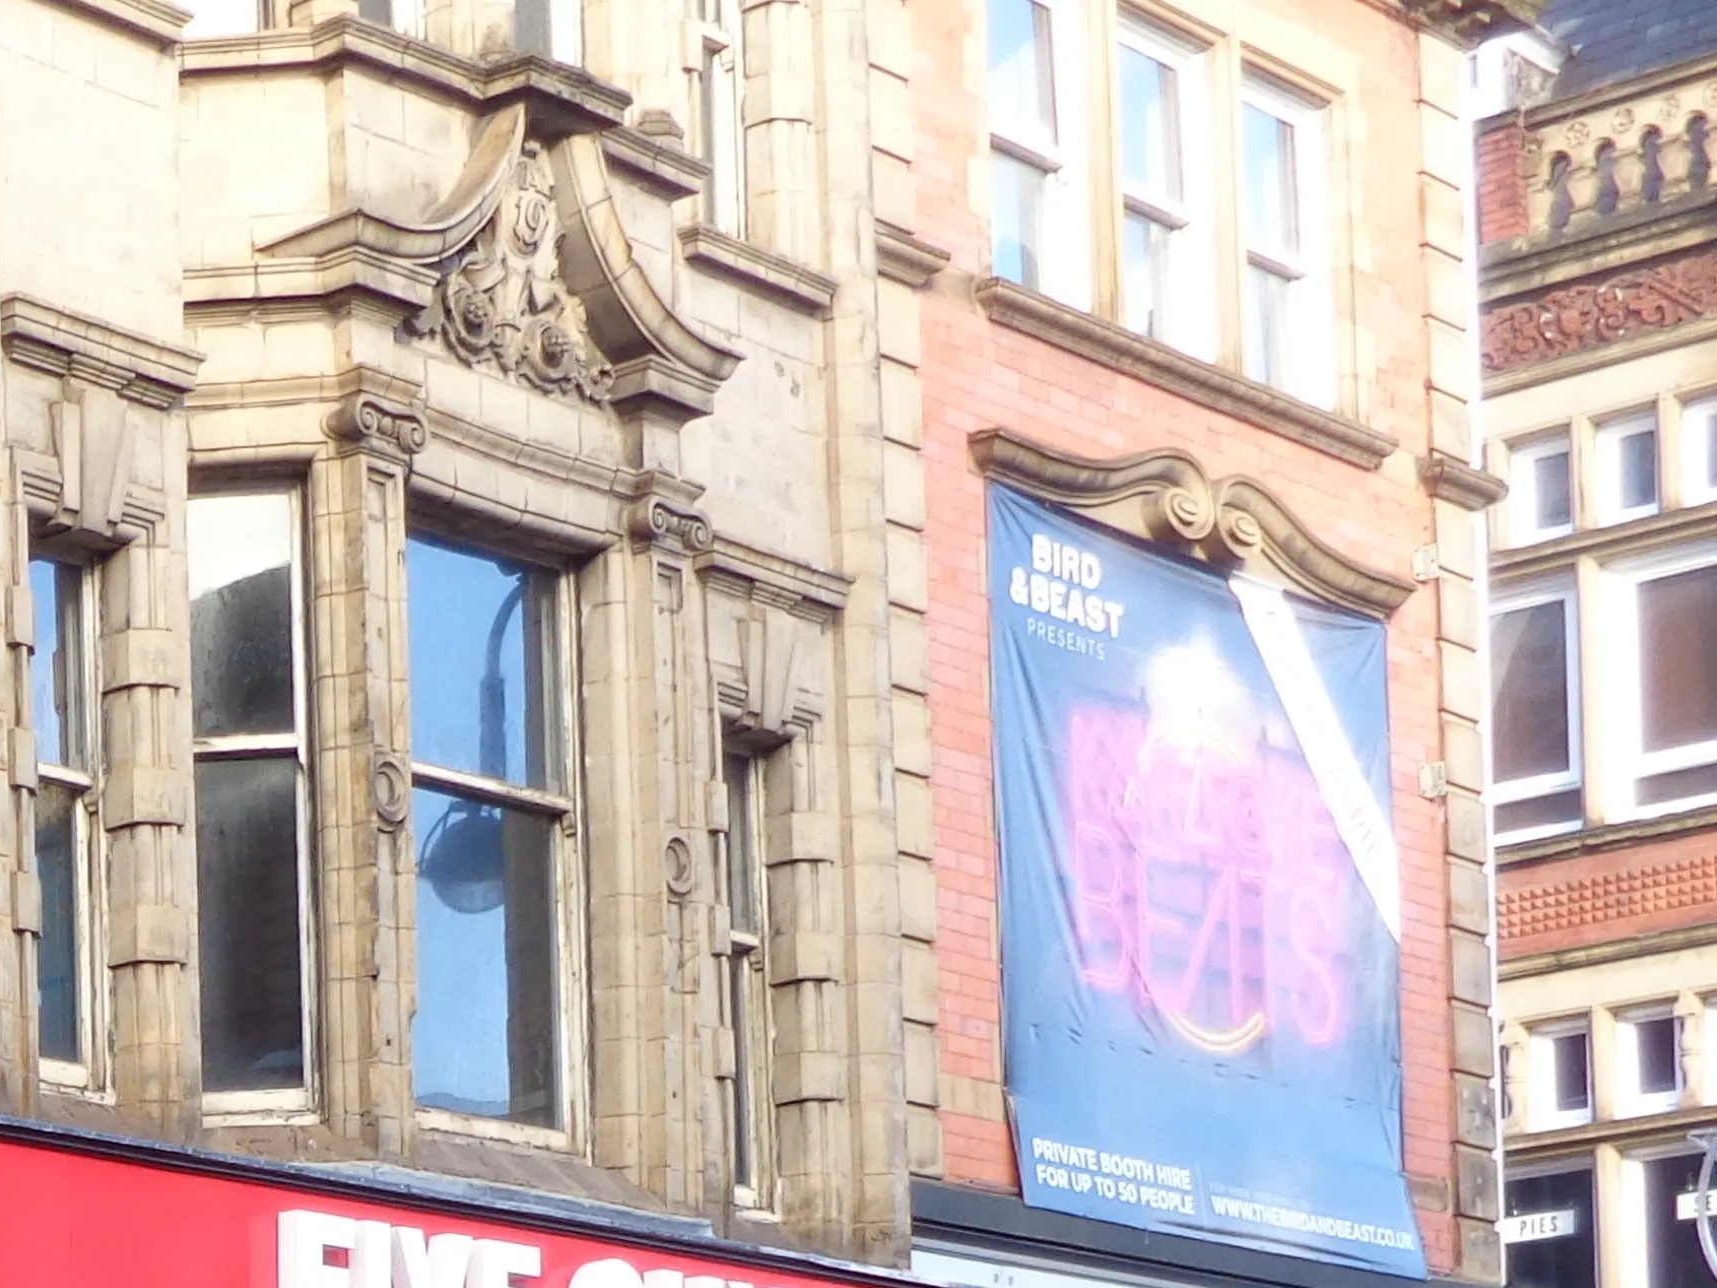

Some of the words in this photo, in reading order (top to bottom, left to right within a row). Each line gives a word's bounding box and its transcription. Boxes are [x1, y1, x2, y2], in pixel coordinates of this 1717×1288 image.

[1032, 533, 1101, 589] BIRD
[1027, 618, 1105, 660] PRESENTS
[1032, 1137, 1097, 1171] PRIVATE
[1100, 1151, 1154, 1182] BOOTH
[1157, 1163, 1192, 1191] HIRE
[1036, 1164, 1069, 1188] FOR
[1071, 1172, 1092, 1194] UP
[1095, 1178, 1115, 1200] TO
[1118, 1183, 1138, 1204] 50
[1140, 1187, 1196, 1216] PEOPLE
[1520, 1215, 1558, 1236] PIES
